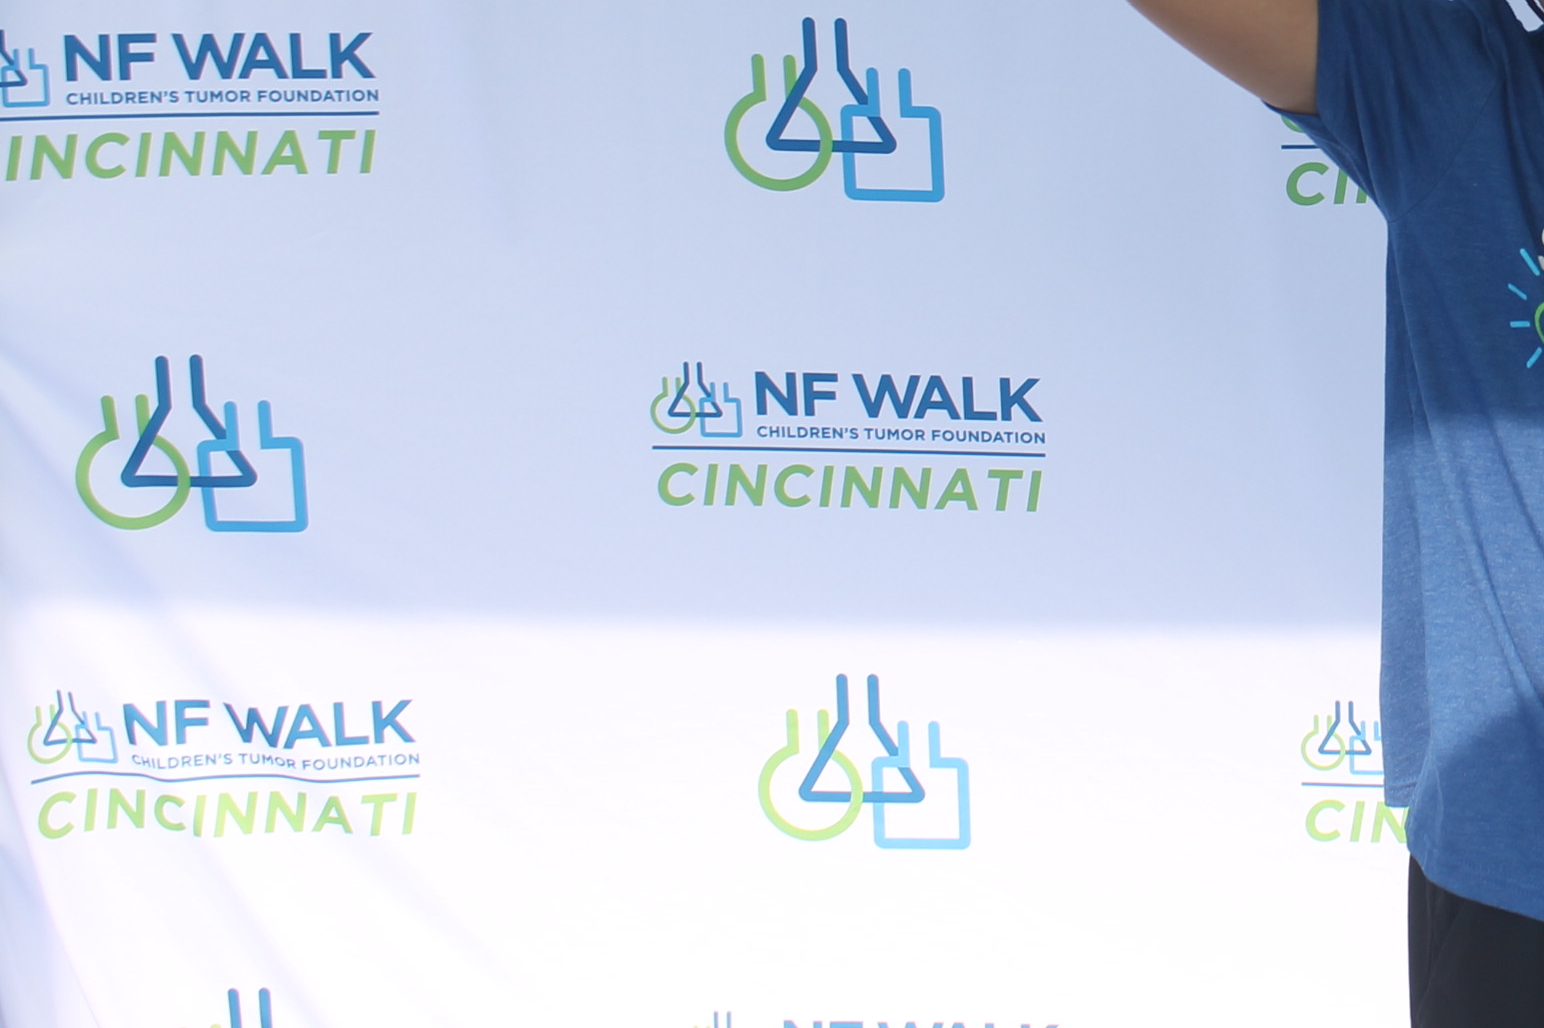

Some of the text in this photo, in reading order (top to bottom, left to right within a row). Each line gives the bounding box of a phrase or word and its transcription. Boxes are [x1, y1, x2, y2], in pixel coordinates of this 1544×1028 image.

[64, 32, 376, 82] NF WALK
[66, 89, 379, 105] CHILDREN'S TUMOR FOUNDATION
[5, 130, 376, 182] INCINNATI
[754, 371, 1043, 422] NF WALK
[757, 426, 1046, 445] CHILDREN'S TUMOR FOUNDATION
[658, 462, 1043, 513] CINCINNATI
[123, 699, 416, 749] NF WALK
[238, 753, 296, 769] TUMOR
[302, 752, 420, 771] FOUNDATION
[38, 788, 417, 839] CINCINNATI
